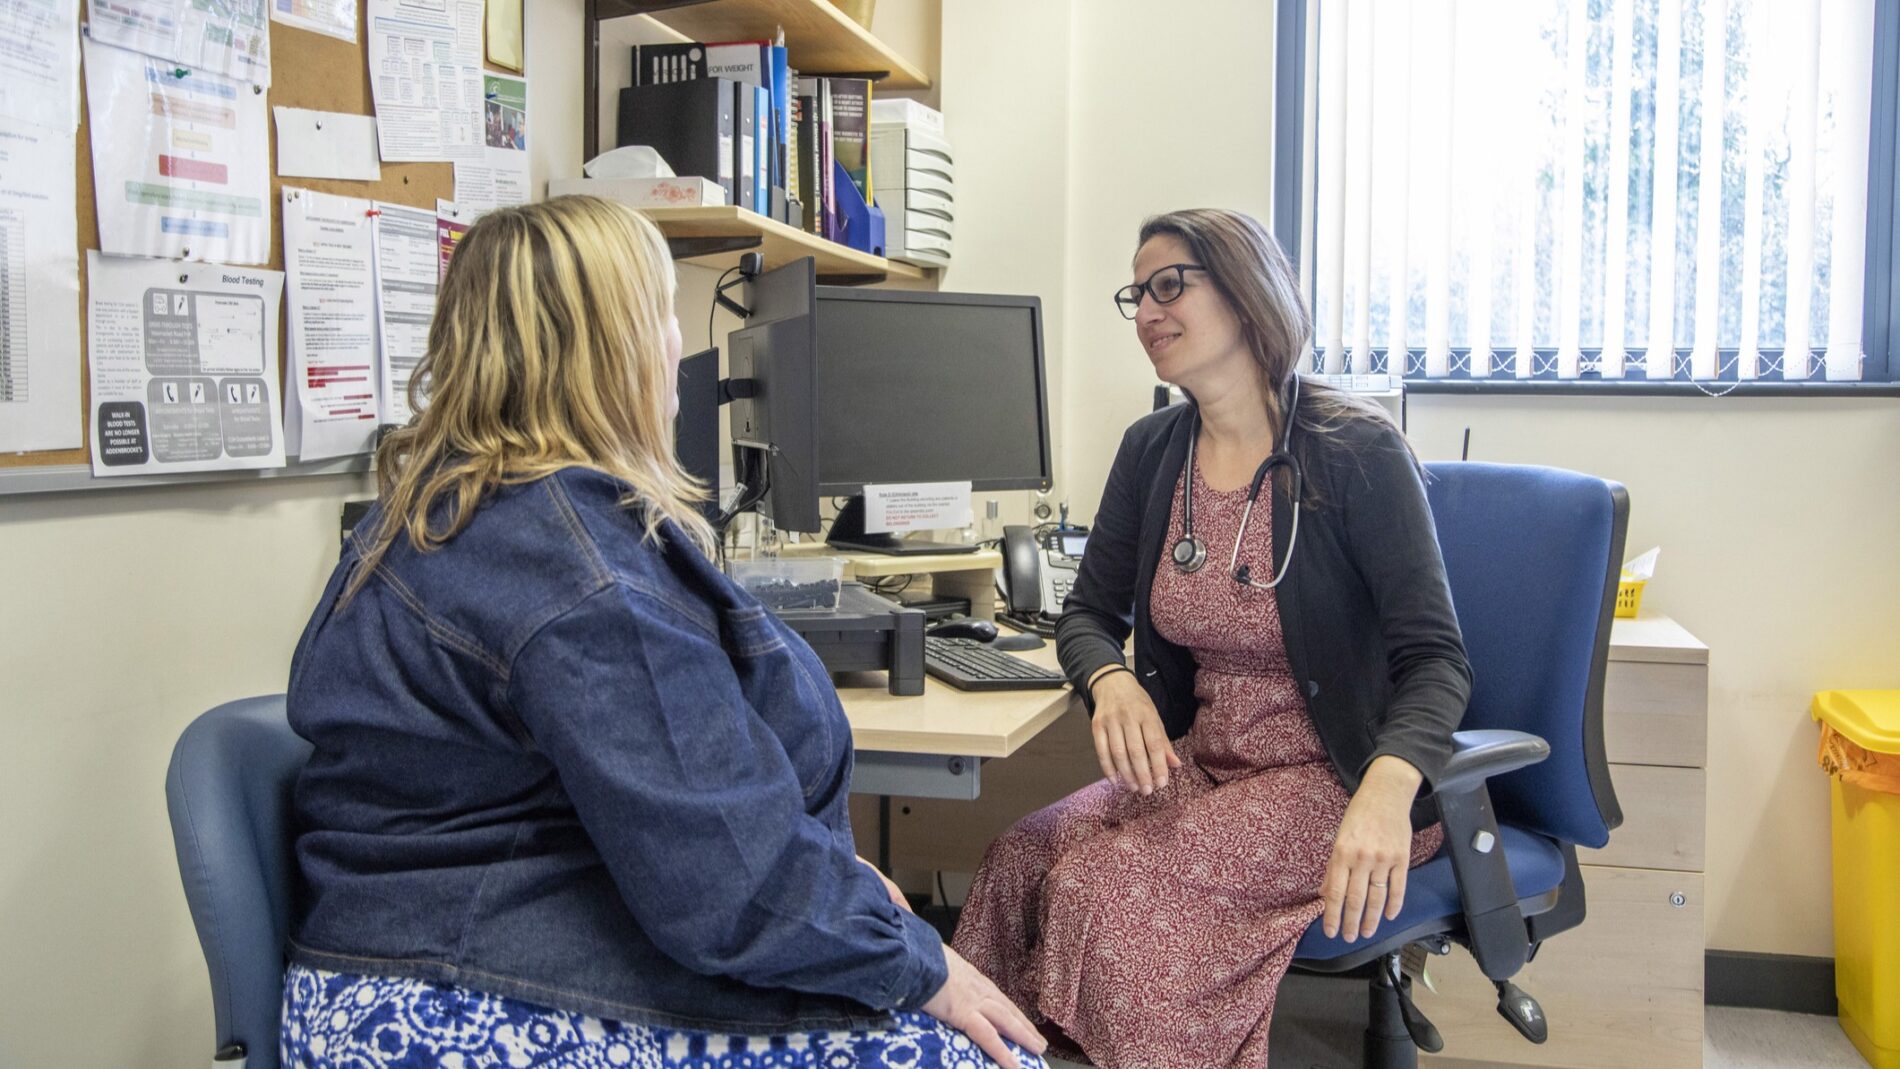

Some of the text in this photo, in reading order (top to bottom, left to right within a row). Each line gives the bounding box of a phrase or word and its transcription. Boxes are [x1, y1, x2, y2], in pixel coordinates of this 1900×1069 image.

[708, 64, 754, 74] FOR WEIGHT
[222, 275, 264, 287] Blood Testing
